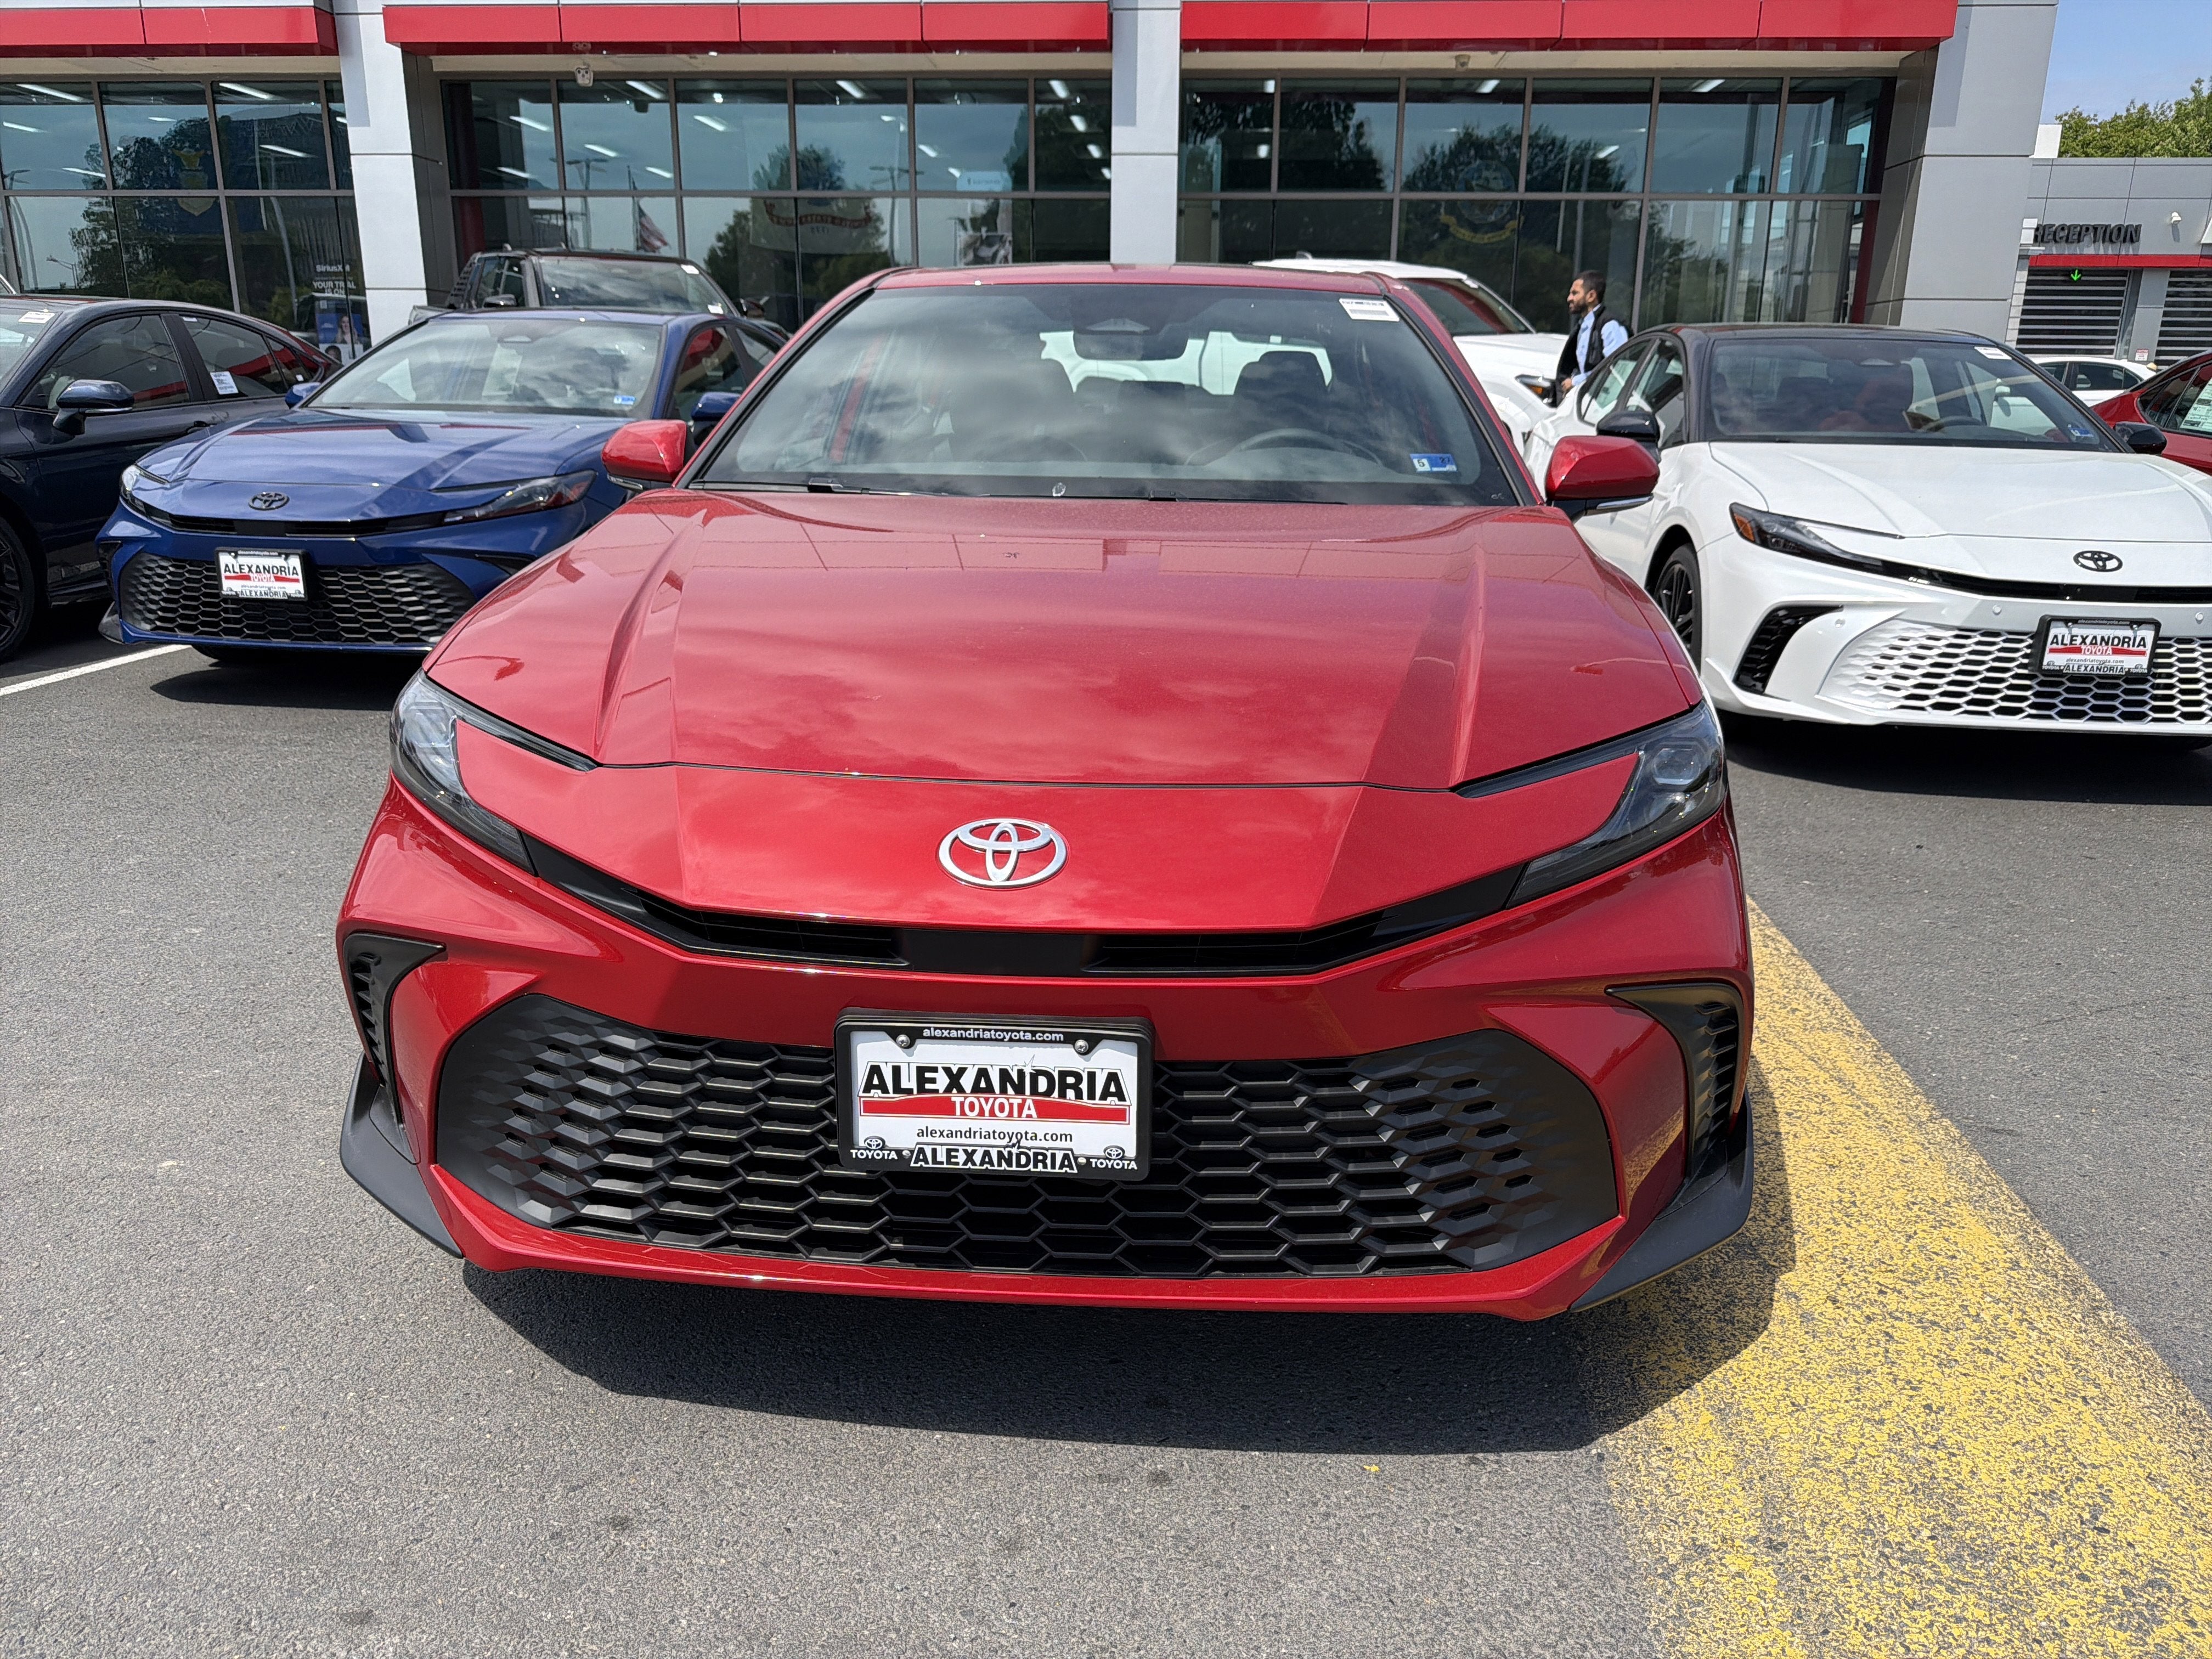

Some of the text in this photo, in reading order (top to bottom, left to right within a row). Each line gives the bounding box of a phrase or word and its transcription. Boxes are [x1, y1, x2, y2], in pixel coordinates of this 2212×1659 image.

[2033, 223, 2142, 243] RECEPTION
[312, 281, 357, 289] YOUR TRAL
[224, 563, 298, 576] ALEXANDRIA
[250, 574, 275, 582] TOYOTA
[240, 589, 287, 598] ALEXANDRIA
[2050, 634, 2147, 648] ALEXANDRIA
[2081, 646, 2112, 655] TOYOTA
[2064, 664, 2124, 674] ALEXANDRIA
[923, 1027, 1064, 1042] alexandriatoyota.com
[861, 1064, 1127, 1103] ALEXANDRIA
[951, 1096, 1038, 1119] TOYOTA
[916, 1126, 1073, 1144] alexandriatoyota.com
[850, 1145, 1138, 1173] TOYOTA ALEXANDRIA TOYOTA
